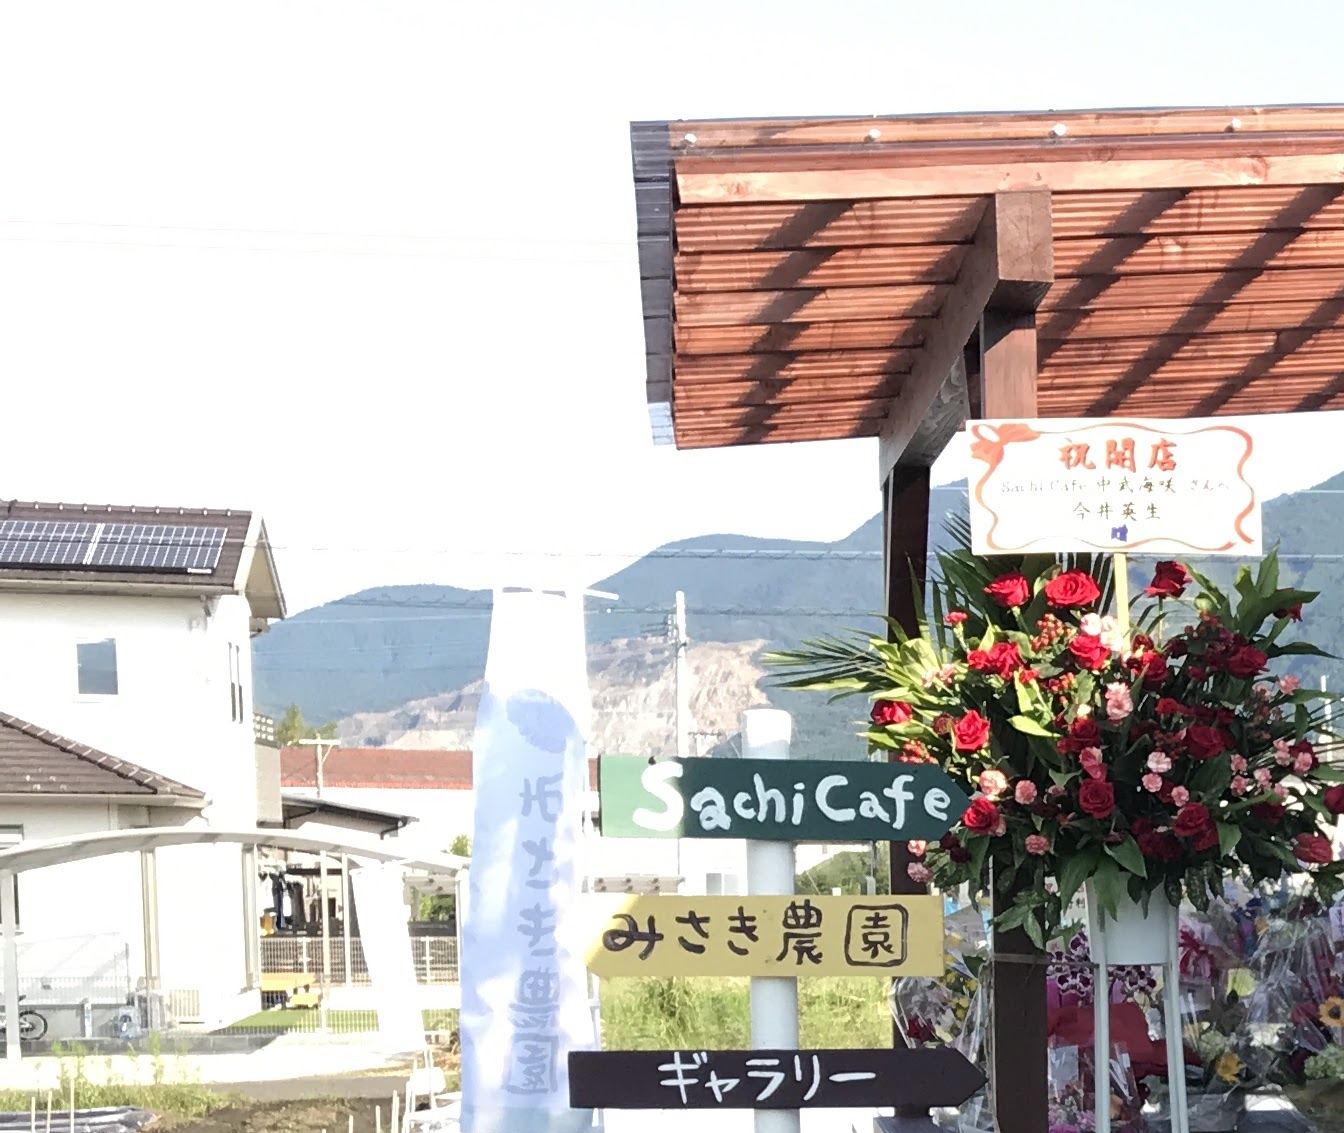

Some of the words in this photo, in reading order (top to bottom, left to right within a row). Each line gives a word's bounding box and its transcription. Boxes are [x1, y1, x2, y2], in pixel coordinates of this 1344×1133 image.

[1058, 438, 1178, 473] 祝開店
[602, 898, 910, 968] みさき農園
[657, 1051, 877, 1104] ギャラリー
